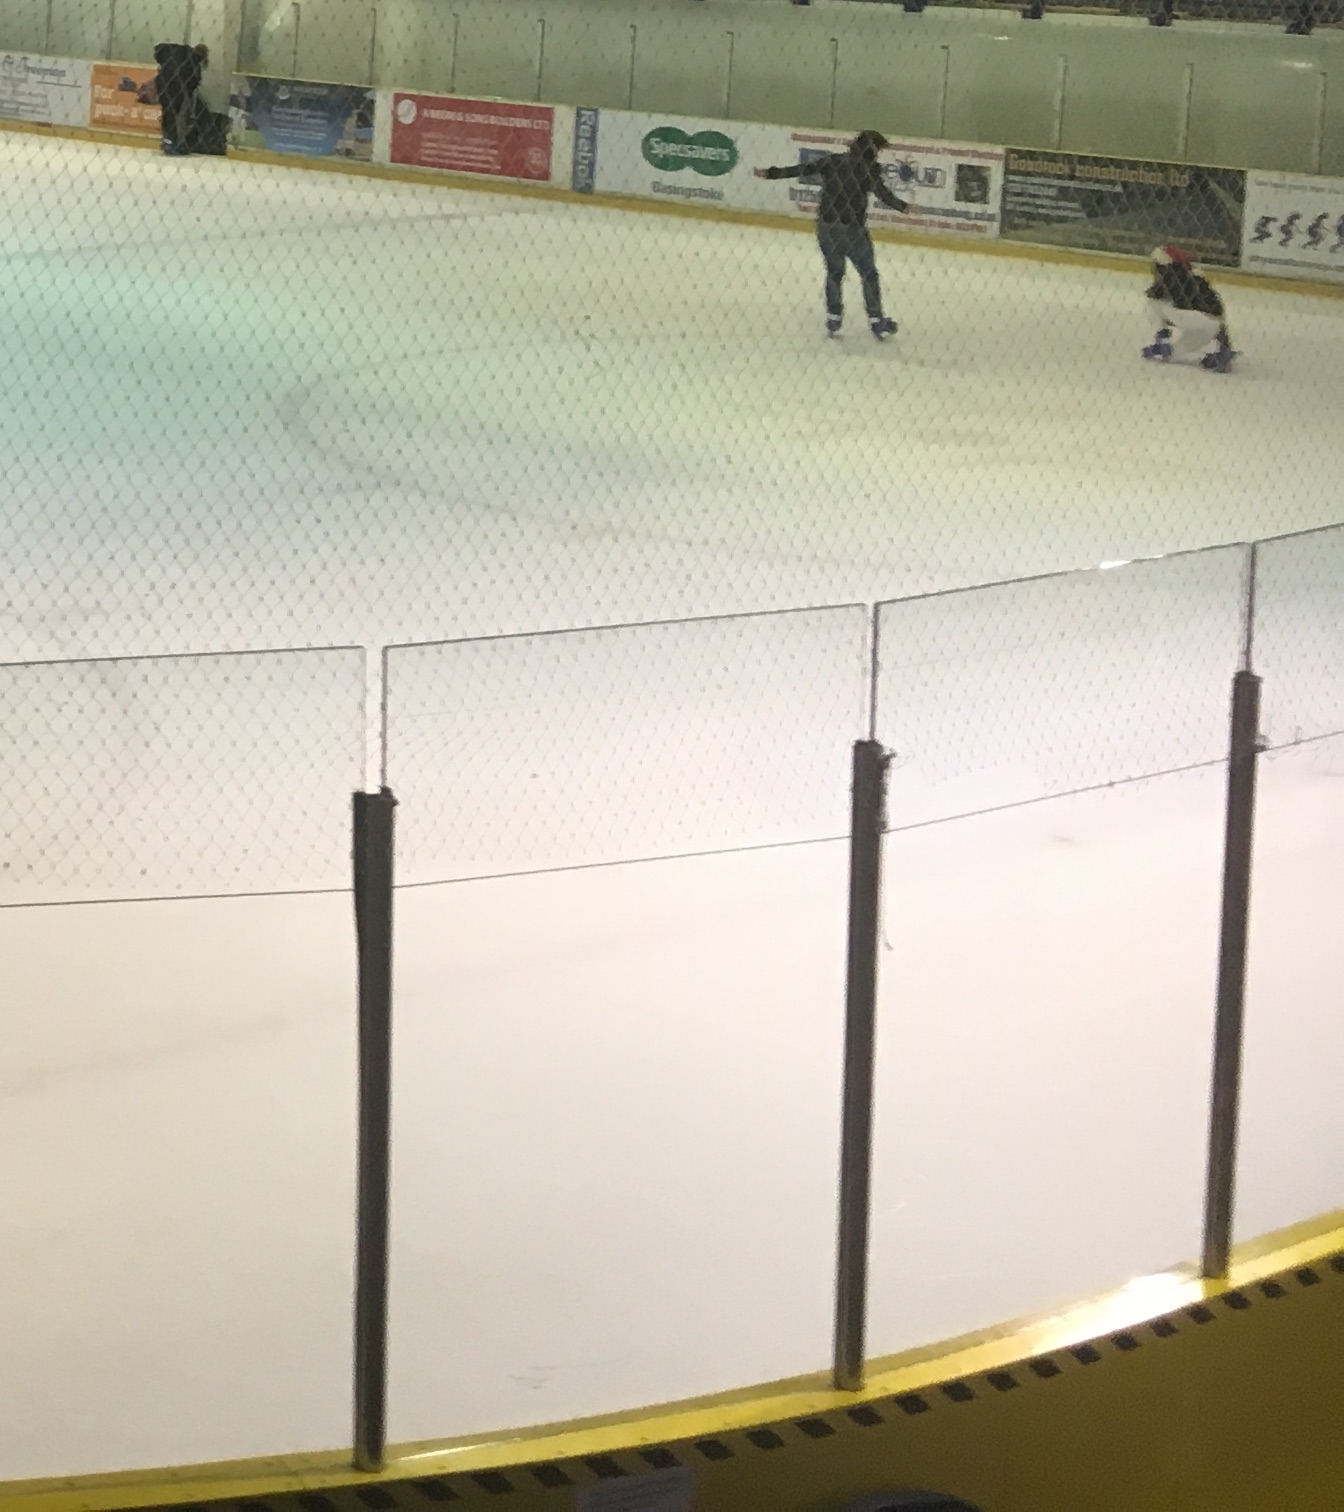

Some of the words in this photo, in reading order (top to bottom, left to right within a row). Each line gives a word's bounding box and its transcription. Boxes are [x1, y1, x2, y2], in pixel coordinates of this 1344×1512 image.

[575, 109, 596, 193] Reebok
[648, 137, 731, 162] Specsavers
[651, 180, 725, 201] Basingstoke
